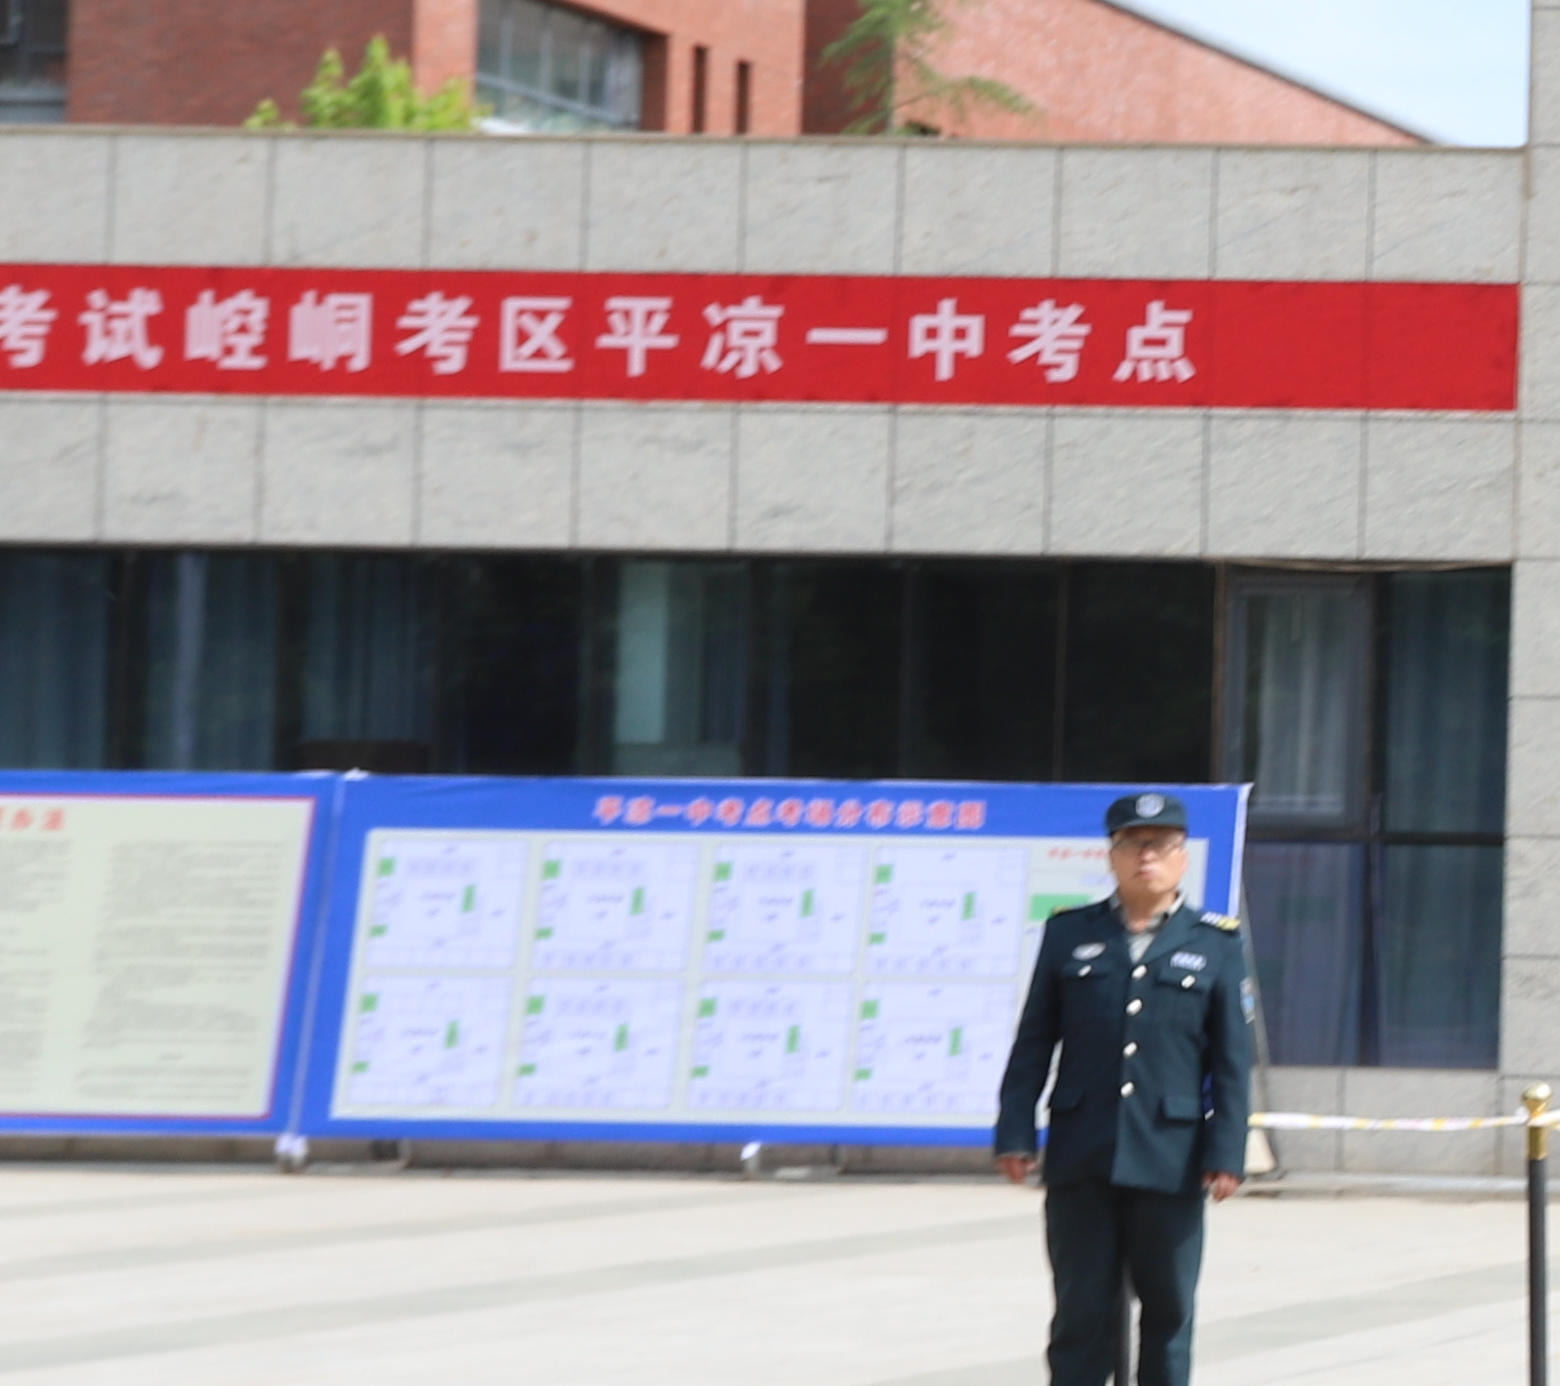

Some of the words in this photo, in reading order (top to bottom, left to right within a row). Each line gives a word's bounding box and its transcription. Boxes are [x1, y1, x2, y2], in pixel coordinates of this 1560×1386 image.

[0, 283, 1197, 384] 考试崆峒考区平凉一中考点
